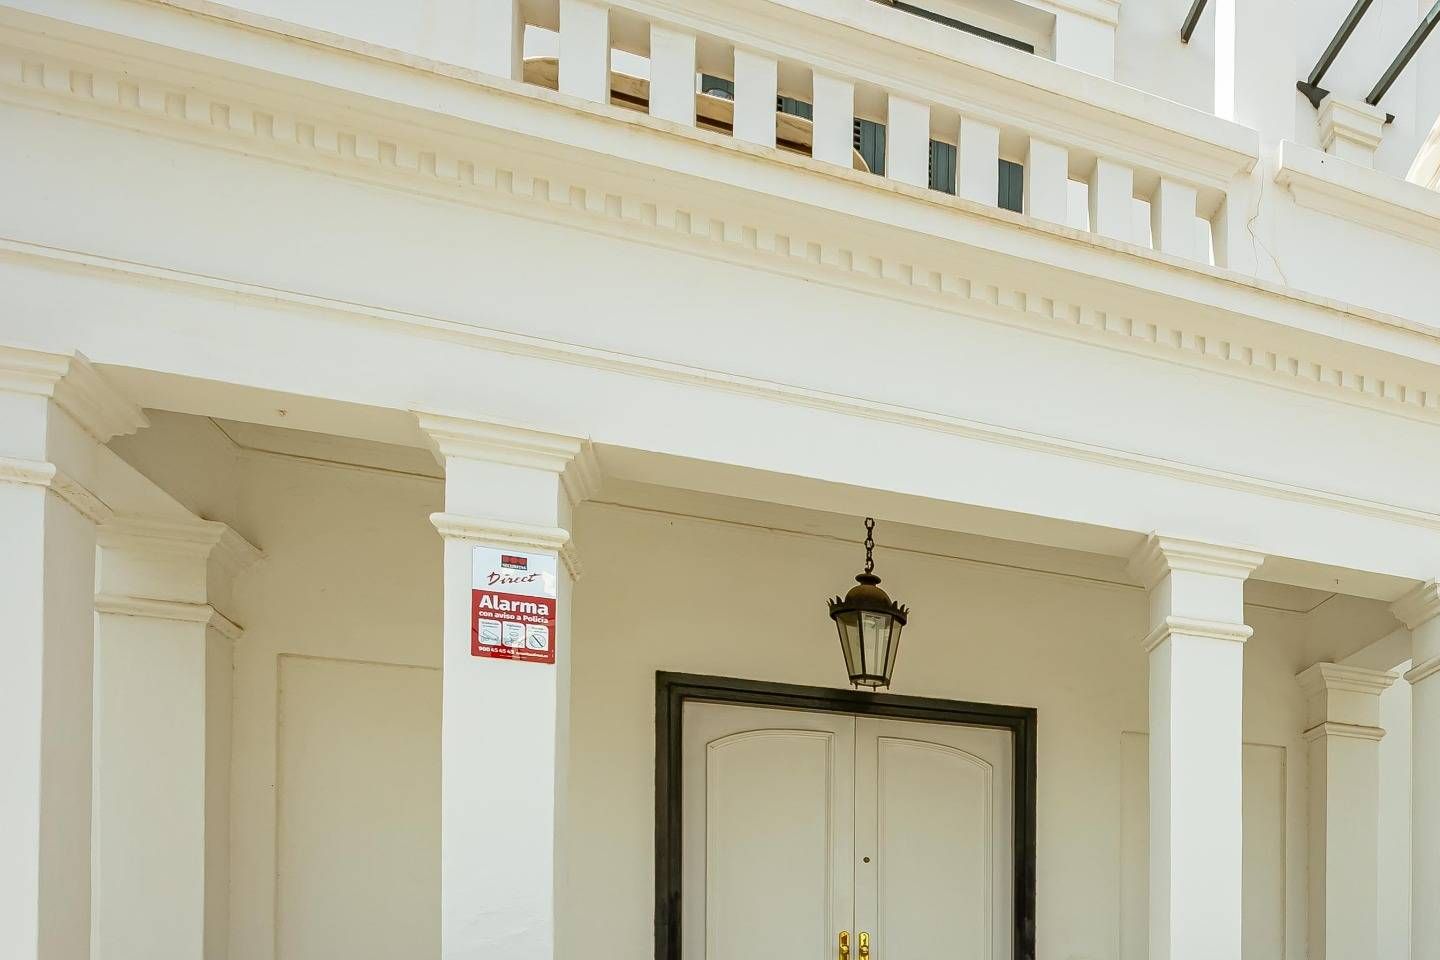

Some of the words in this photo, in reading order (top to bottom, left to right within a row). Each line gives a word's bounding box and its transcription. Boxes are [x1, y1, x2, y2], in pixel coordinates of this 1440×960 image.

[487, 571, 541, 585] Direct
[479, 595, 548, 615] Alarma
[494, 611, 515, 620] aviso
